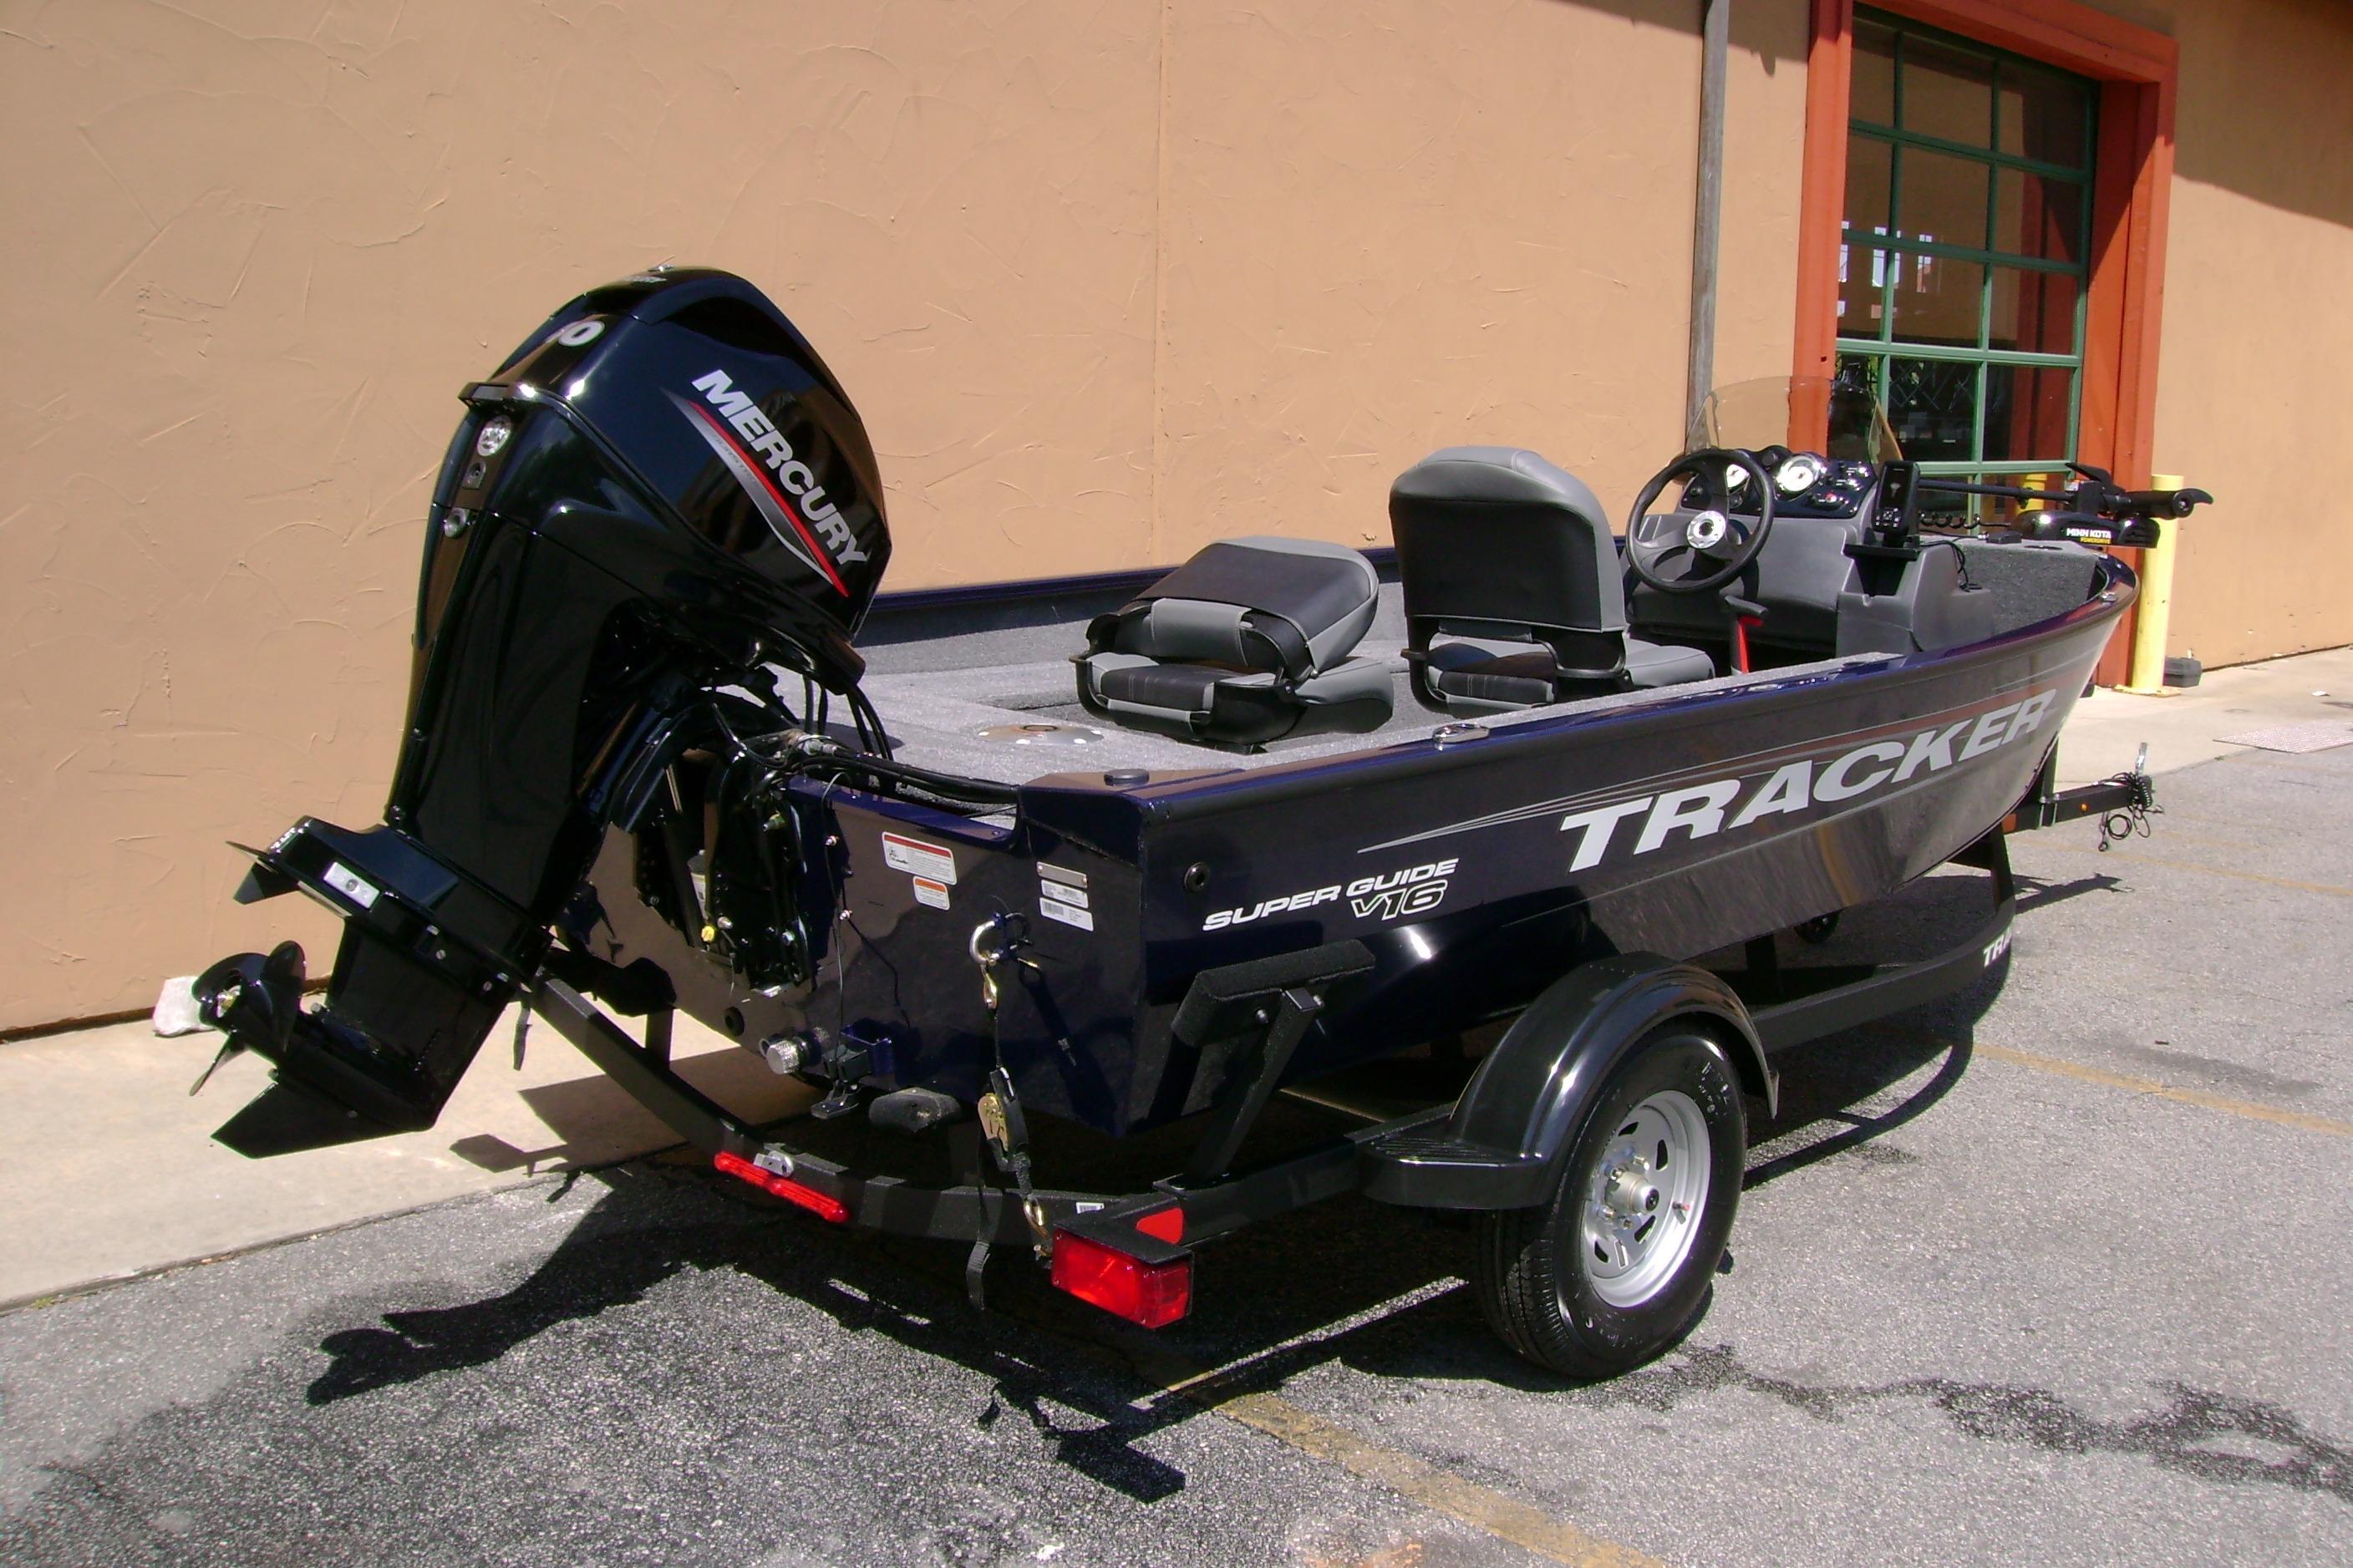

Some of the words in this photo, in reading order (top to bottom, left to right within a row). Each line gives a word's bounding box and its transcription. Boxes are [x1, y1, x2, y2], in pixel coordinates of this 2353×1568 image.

[692, 369, 867, 566] MERCURY
[2066, 528, 2089, 537] MINN
[2089, 530, 2112, 539] KOTA
[1559, 688, 2056, 873] TRACKER
[1202, 885, 1341, 931] SUPER
[1345, 857, 1459, 897] GUIDE
[1350, 880, 1447, 920] V16
